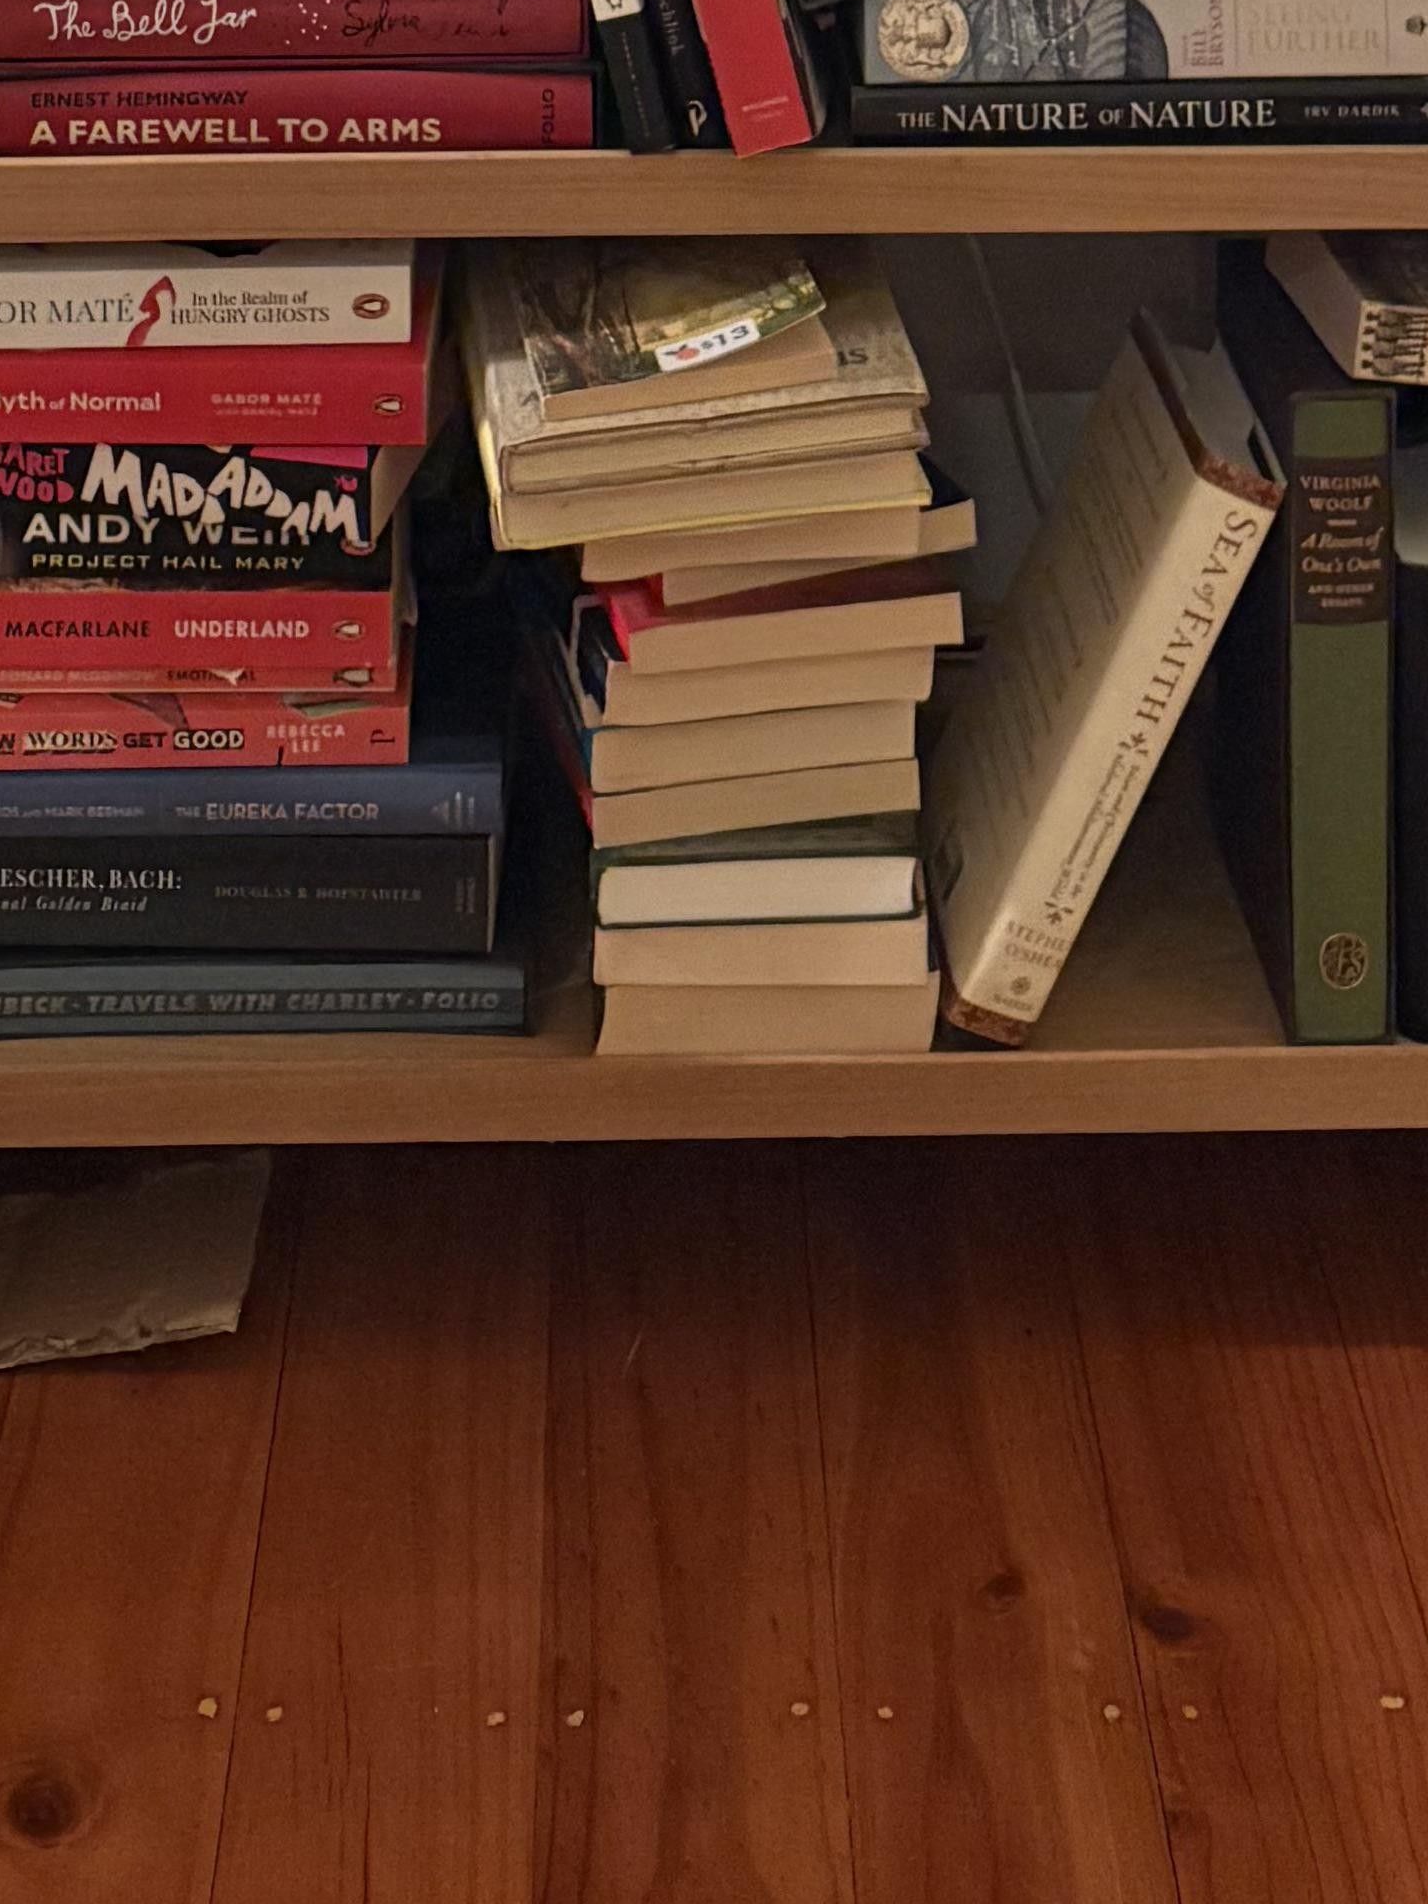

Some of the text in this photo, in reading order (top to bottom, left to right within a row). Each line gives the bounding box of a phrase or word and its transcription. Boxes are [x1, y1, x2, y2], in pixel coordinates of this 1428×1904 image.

[33, 1, 96, 40] The
[102, 0, 188, 42] Bell
[30, 119, 441, 145] A FAREWELL TO ARMS
[898, 100, 1276, 133] THE NATURE OF NATURE
[47, 293, 134, 324] MATÉ
[1201, 510, 1258, 579] SEA
[32, 554, 305, 570] PROJECT HAIL MARY
[174, 621, 309, 638] UNDERLAND
[1135, 608, 1215, 726] FAITH
